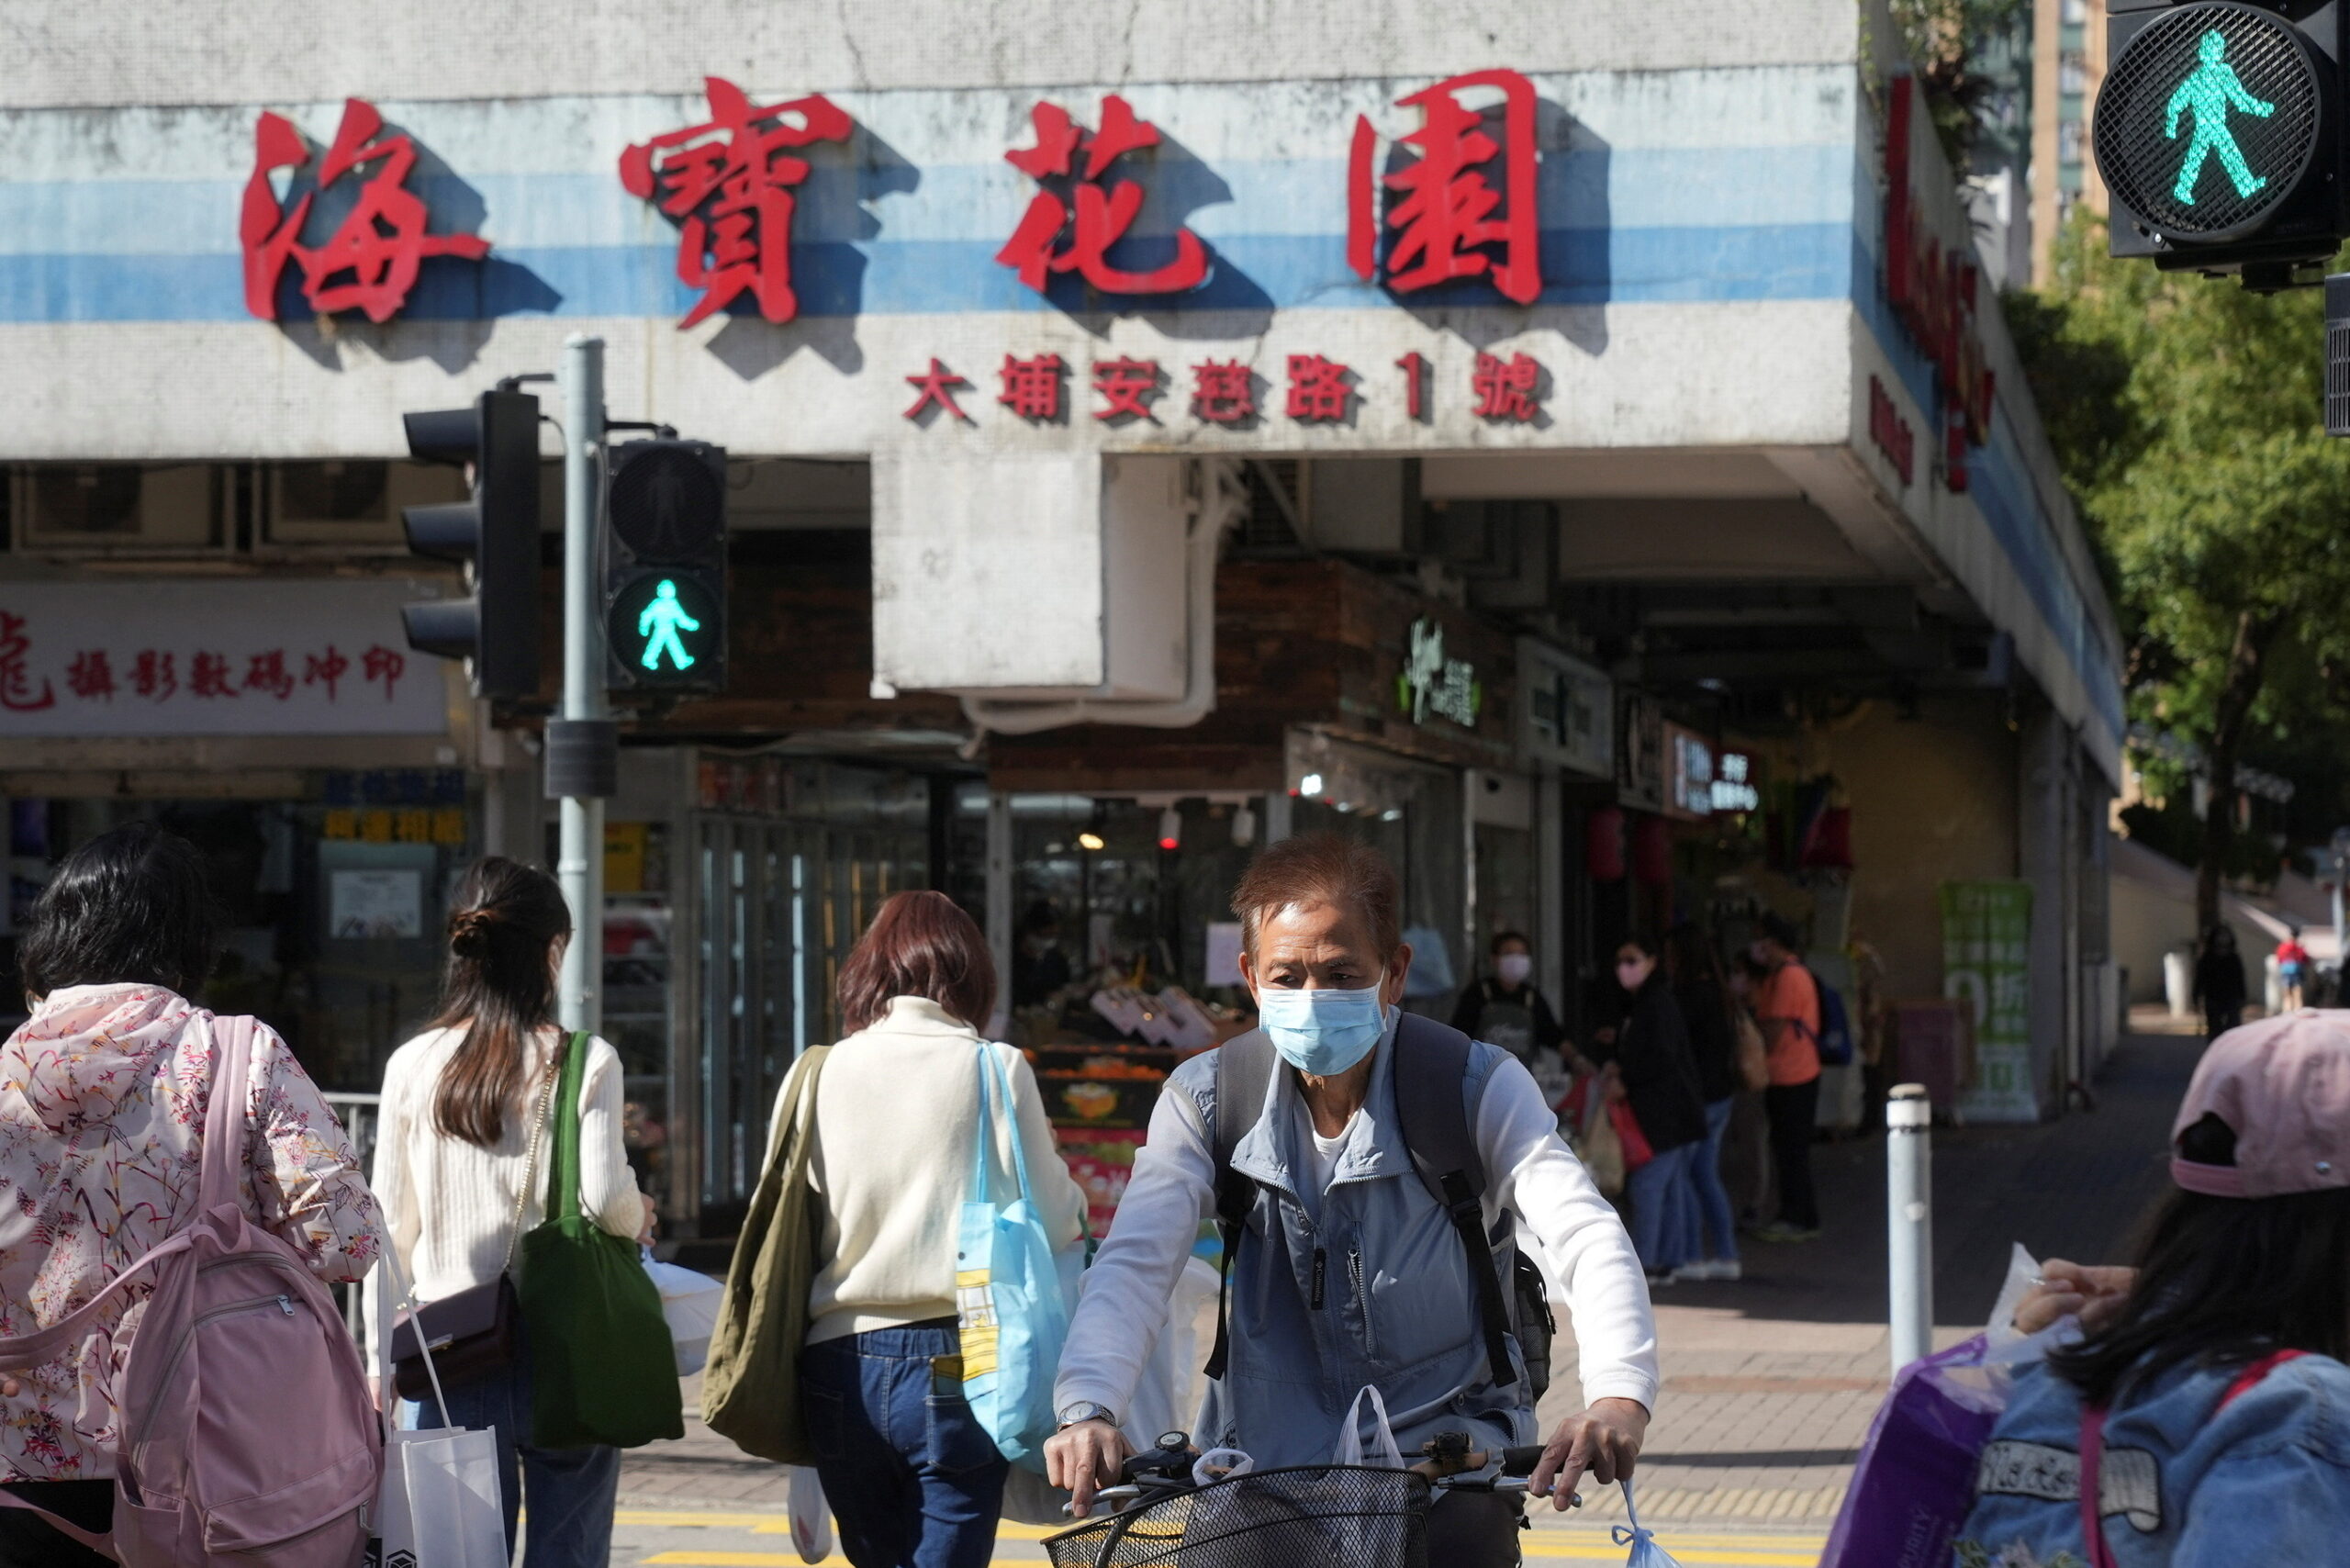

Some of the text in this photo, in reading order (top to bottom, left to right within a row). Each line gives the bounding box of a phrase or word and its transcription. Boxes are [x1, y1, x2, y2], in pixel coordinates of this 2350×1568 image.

[240, 67, 1543, 329] 海寶花園
[903, 350, 1540, 423] 大埔安慈路1號
[1315, 1269, 1323, 1302] Columbia
